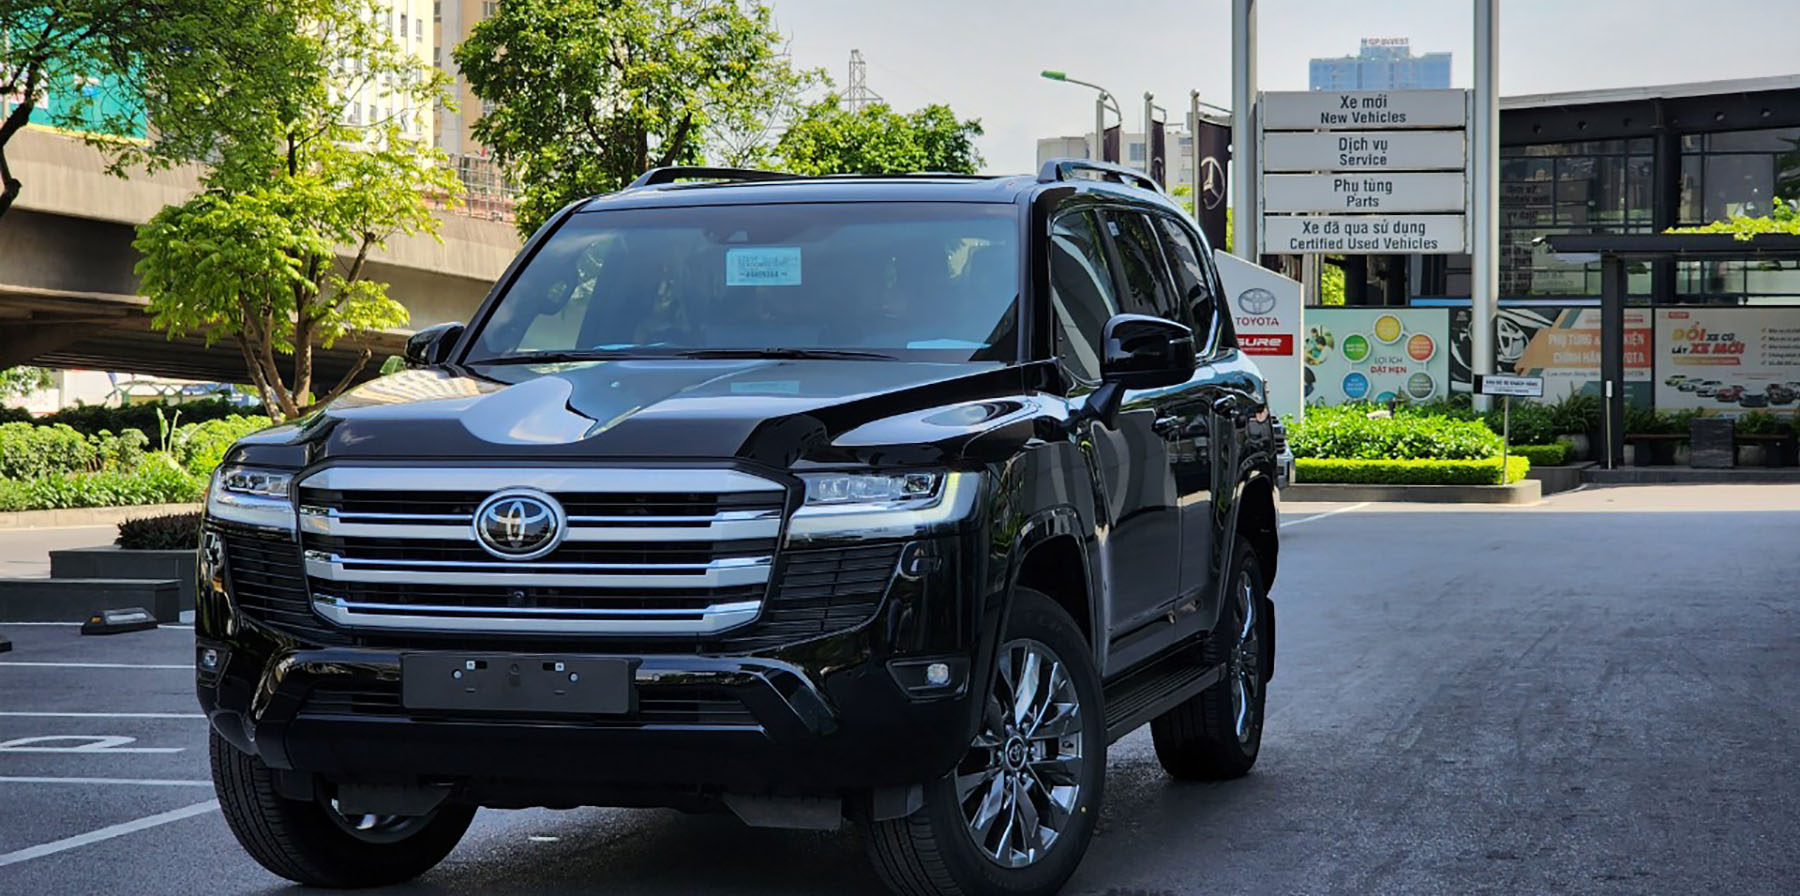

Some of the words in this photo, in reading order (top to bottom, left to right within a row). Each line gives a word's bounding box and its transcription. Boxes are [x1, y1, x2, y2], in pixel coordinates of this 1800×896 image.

[1340, 96, 1358, 108] Xe
[1362, 94, 1387, 108] mới
[1320, 112, 1348, 124] New
[1352, 111, 1407, 124] Vehicles
[1338, 137, 1368, 154] Dịch
[1372, 140, 1388, 154] vụ
[1339, 154, 1387, 166] Service
[1334, 179, 1359, 196] Phụ
[1363, 179, 1393, 194] tùng
[1346, 195, 1380, 207] Parts
[1302, 221, 1319, 234] Xe
[1323, 221, 1341, 234] đã
[1344, 223, 1369, 236] qua
[1373, 218, 1389, 234] sử
[1393, 221, 1426, 237] dụng
[1290, 237, 1344, 250] Certified
[1347, 237, 1380, 250] Used
[1383, 236, 1438, 250] Vehicles
[1235, 316, 1280, 327] TOYOTA
